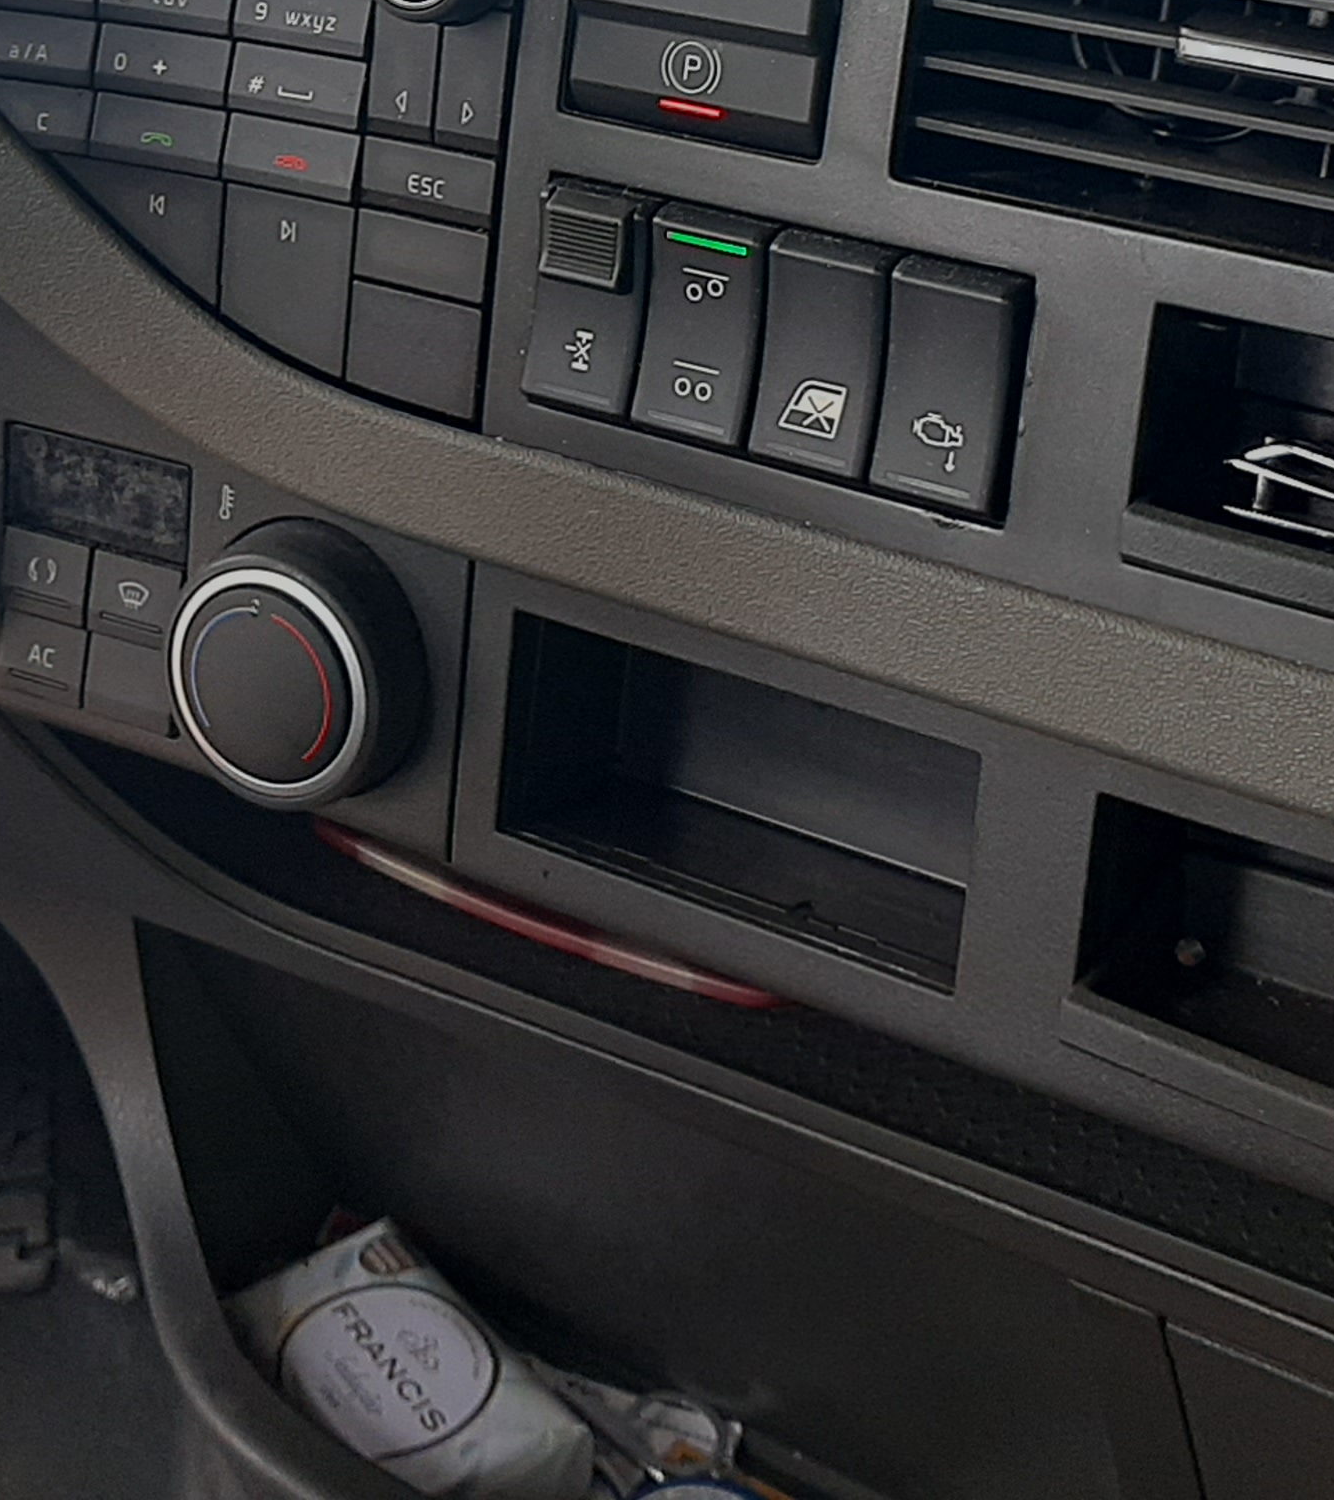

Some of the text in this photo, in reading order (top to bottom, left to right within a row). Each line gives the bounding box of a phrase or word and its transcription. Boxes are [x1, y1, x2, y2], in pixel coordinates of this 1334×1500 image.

[254, 1, 338, 34] 9 wxyz
[36, 112, 50, 132] C
[407, 173, 446, 200] ESC
[28, 643, 55, 669] AC
[330, 1300, 449, 1433] FRANCIS
